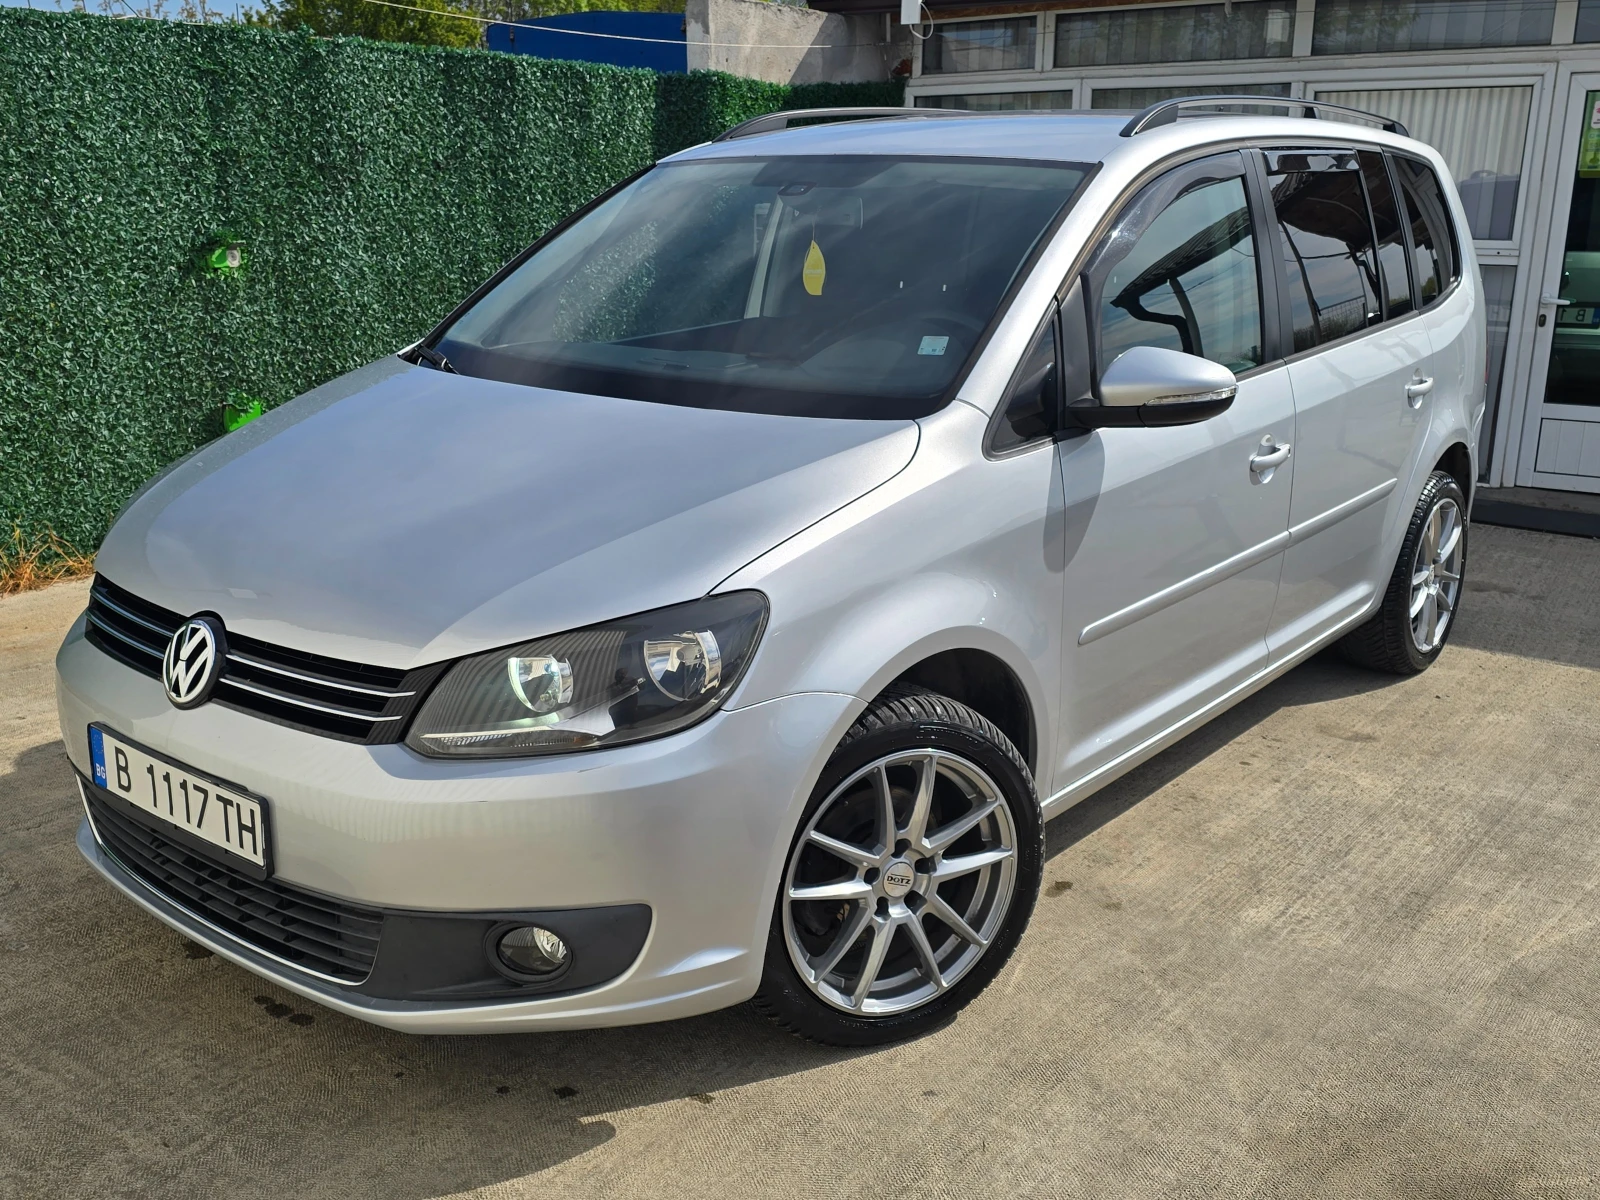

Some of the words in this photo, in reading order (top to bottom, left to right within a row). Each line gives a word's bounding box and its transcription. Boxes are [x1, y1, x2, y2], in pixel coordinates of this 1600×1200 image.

[96, 763, 105, 779] BG
[114, 745, 132, 793] B
[886, 875, 911, 885] DOTZ
